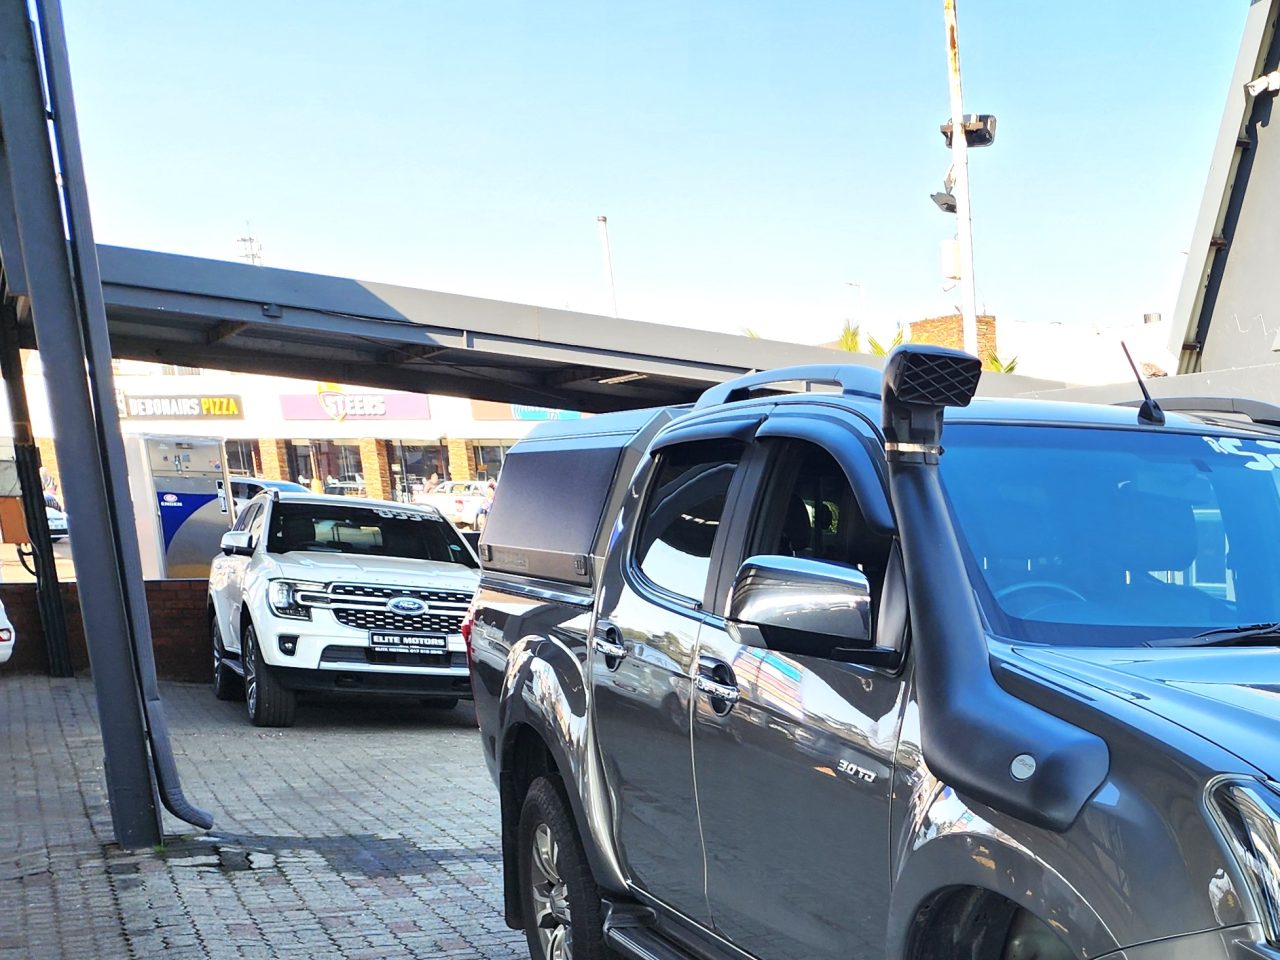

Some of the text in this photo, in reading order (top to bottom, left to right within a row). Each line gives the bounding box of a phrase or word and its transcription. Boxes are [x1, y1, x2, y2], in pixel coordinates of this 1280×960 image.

[128, 396, 239, 416] DEBONAIRS PIZZA
[324, 394, 387, 416] STEERS
[373, 635, 445, 646] ELITE MOTORS
